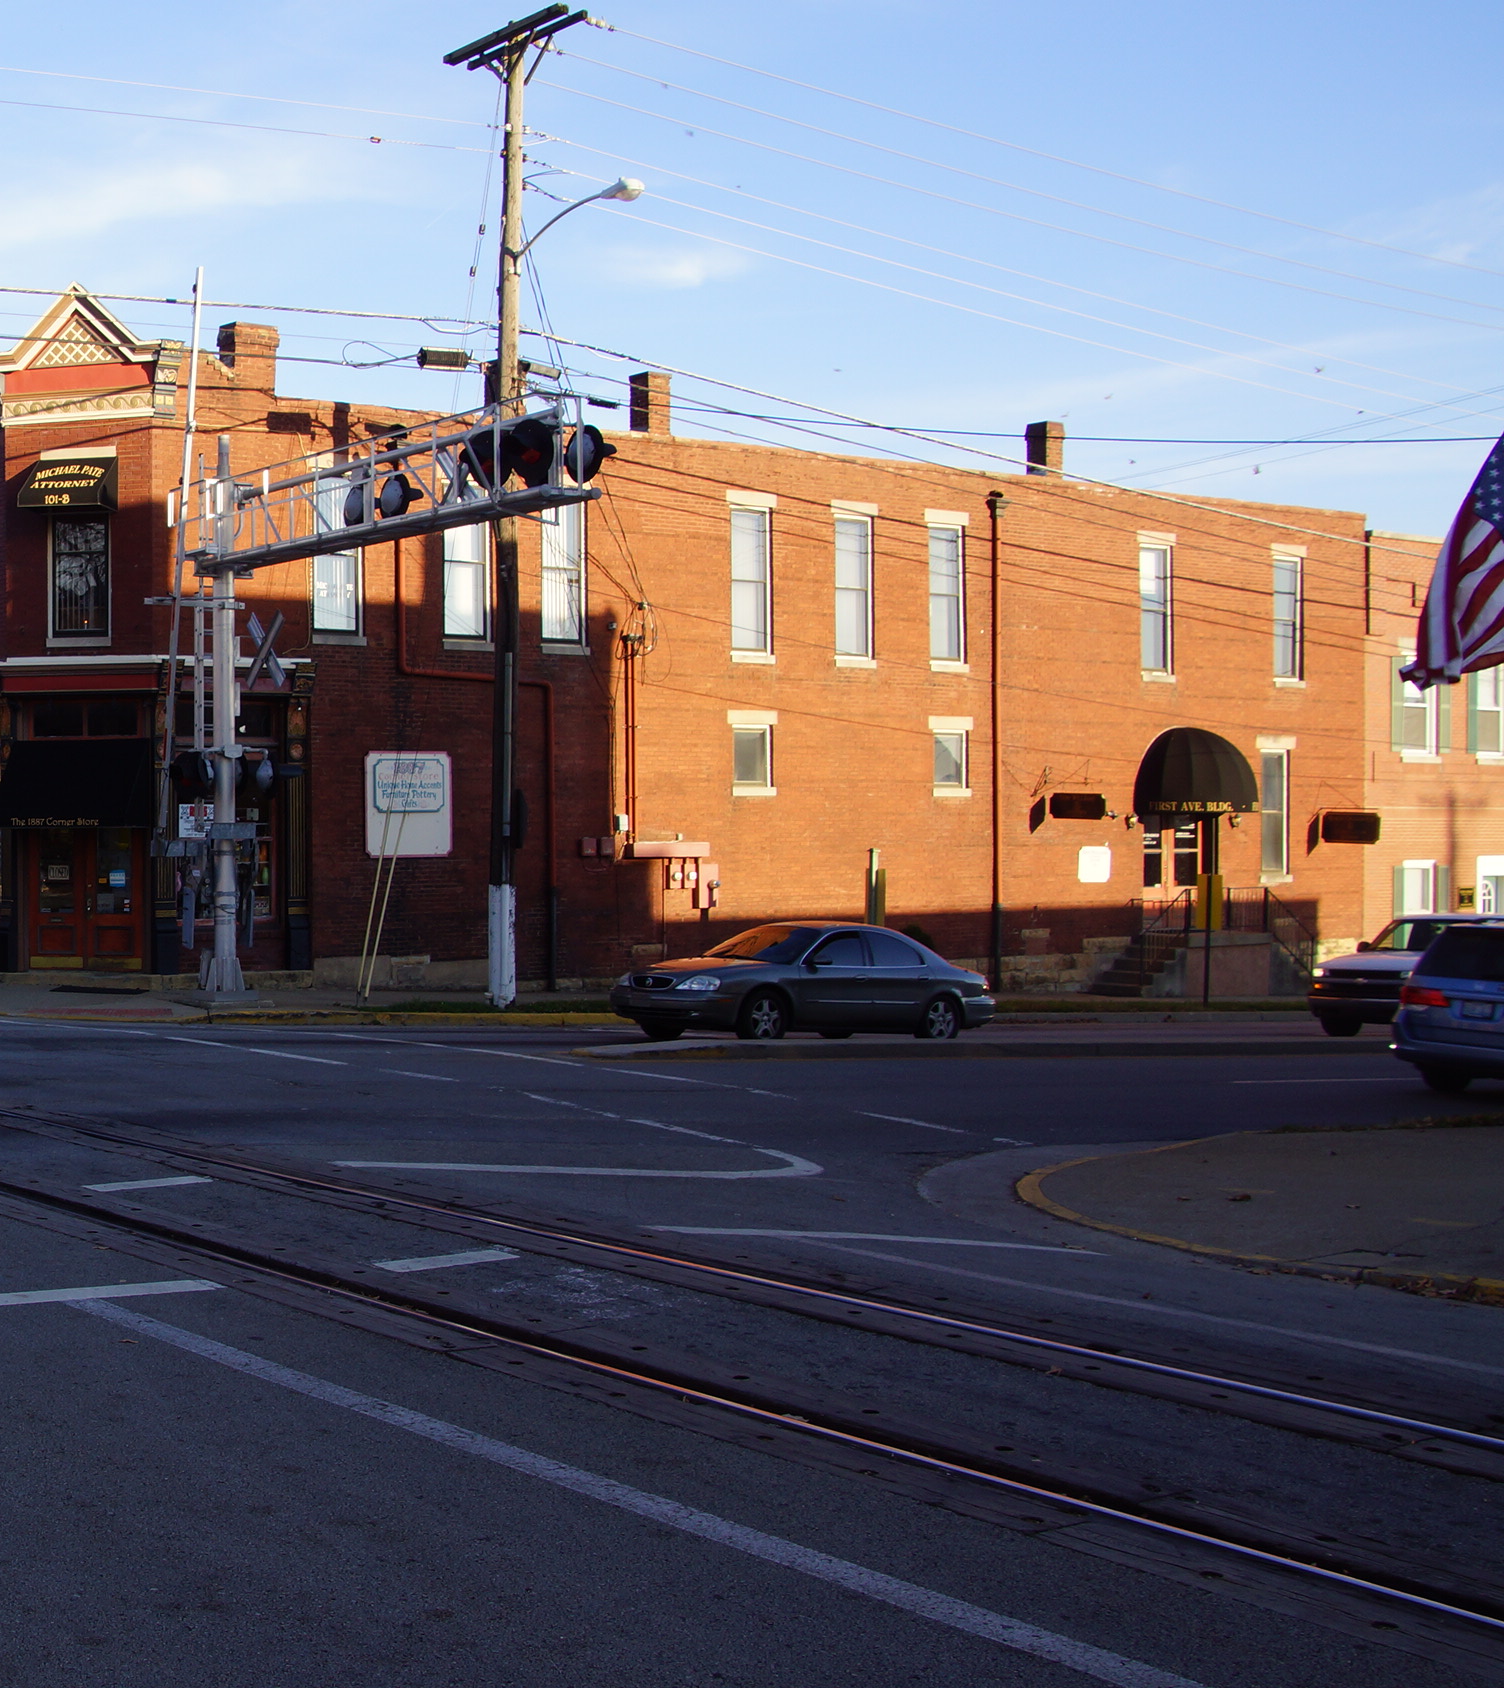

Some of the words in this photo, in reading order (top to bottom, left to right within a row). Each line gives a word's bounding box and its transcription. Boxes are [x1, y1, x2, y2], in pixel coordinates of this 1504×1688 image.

[35, 465, 81, 480] MICHAEL
[81, 465, 105, 478] PATE
[30, 479, 98, 489] ATTORNEY
[44, 493, 70, 505] 101-B
[418, 780, 442, 789] Accents
[1149, 801, 1177, 811] FIRST
[1181, 801, 1204, 811] AVE.
[1206, 801, 1234, 811] BLDG.
[10, 817, 26, 826] The
[27, 817, 45, 826] 1887
[45, 817, 75, 826] Corner
[76, 817, 99, 826] Store
